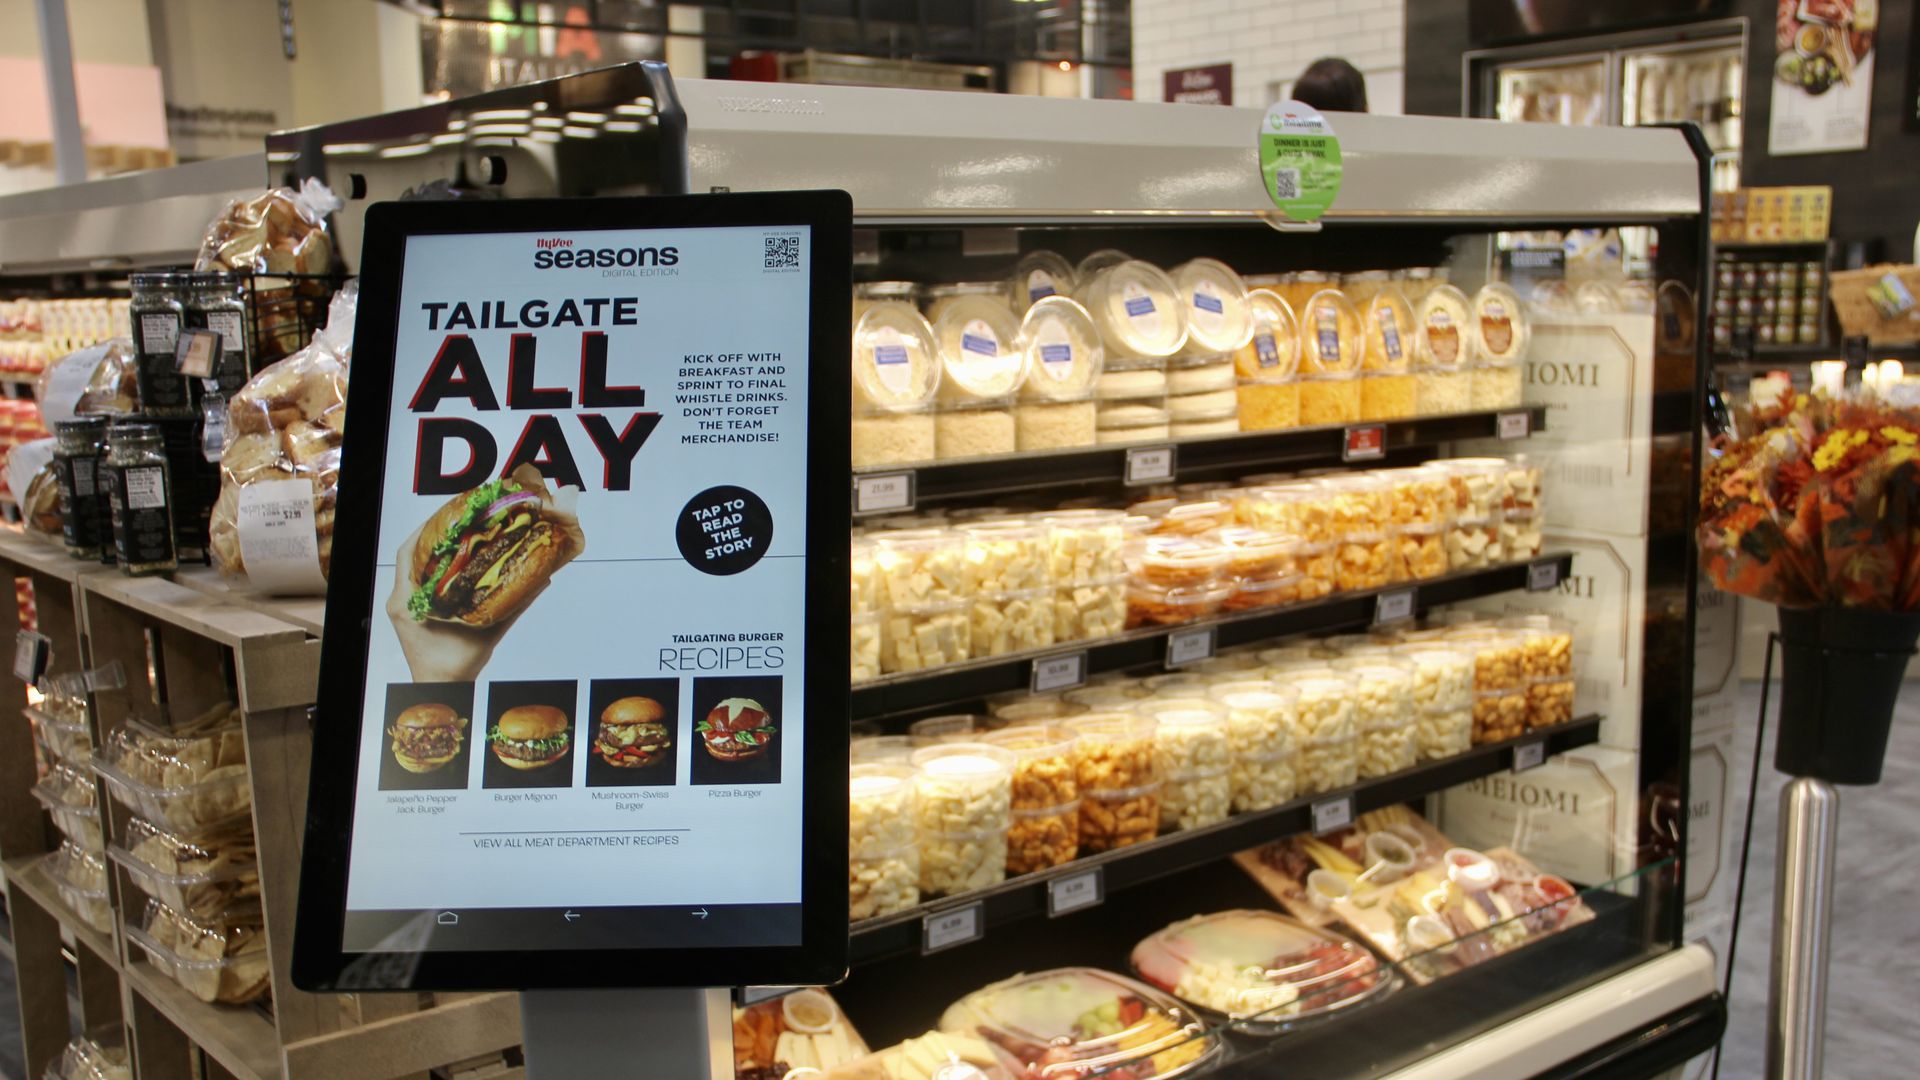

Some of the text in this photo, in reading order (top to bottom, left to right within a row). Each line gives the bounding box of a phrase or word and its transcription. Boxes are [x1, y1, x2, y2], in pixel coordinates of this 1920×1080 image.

[534, 247, 679, 269] seasons
[602, 268, 679, 278] DIGITAL EDITION
[421, 297, 638, 330] TAILGATE
[684, 353, 781, 363] KICK OFF WITH
[408, 331, 645, 412] ALL
[679, 366, 786, 377] BREAKFAST AND
[1527, 361, 1600, 387] IOMI
[677, 379, 786, 390] SPRINT TO FINAL
[675, 392, 787, 404] WHISTLE DRINKS.
[683, 406, 779, 417] DON'T FORGET
[698, 420, 763, 430] THE TEAM
[681, 433, 779, 444] MERCHANDISE!
[413, 412, 664, 496] DAY
[692, 499, 745, 521] TAP TO
[702, 513, 743, 533] READ
[711, 527, 741, 543] THE
[705, 537, 753, 559] STORY
[672, 632, 784, 643] TAILGATING BURGER
[659, 646, 784, 671] RECIPES
[386, 793, 457, 805] Jalapeño Pepper
[494, 793, 558, 803] Burger Mignon
[592, 790, 669, 800] Mushroom-Swiss
[708, 788, 762, 799] Pizza Burger
[397, 805, 445, 815] Jack Burger
[615, 801, 644, 812] Burger
[474, 835, 679, 848] VIEW ALL MEAT DEPARTMENT RECIPES
